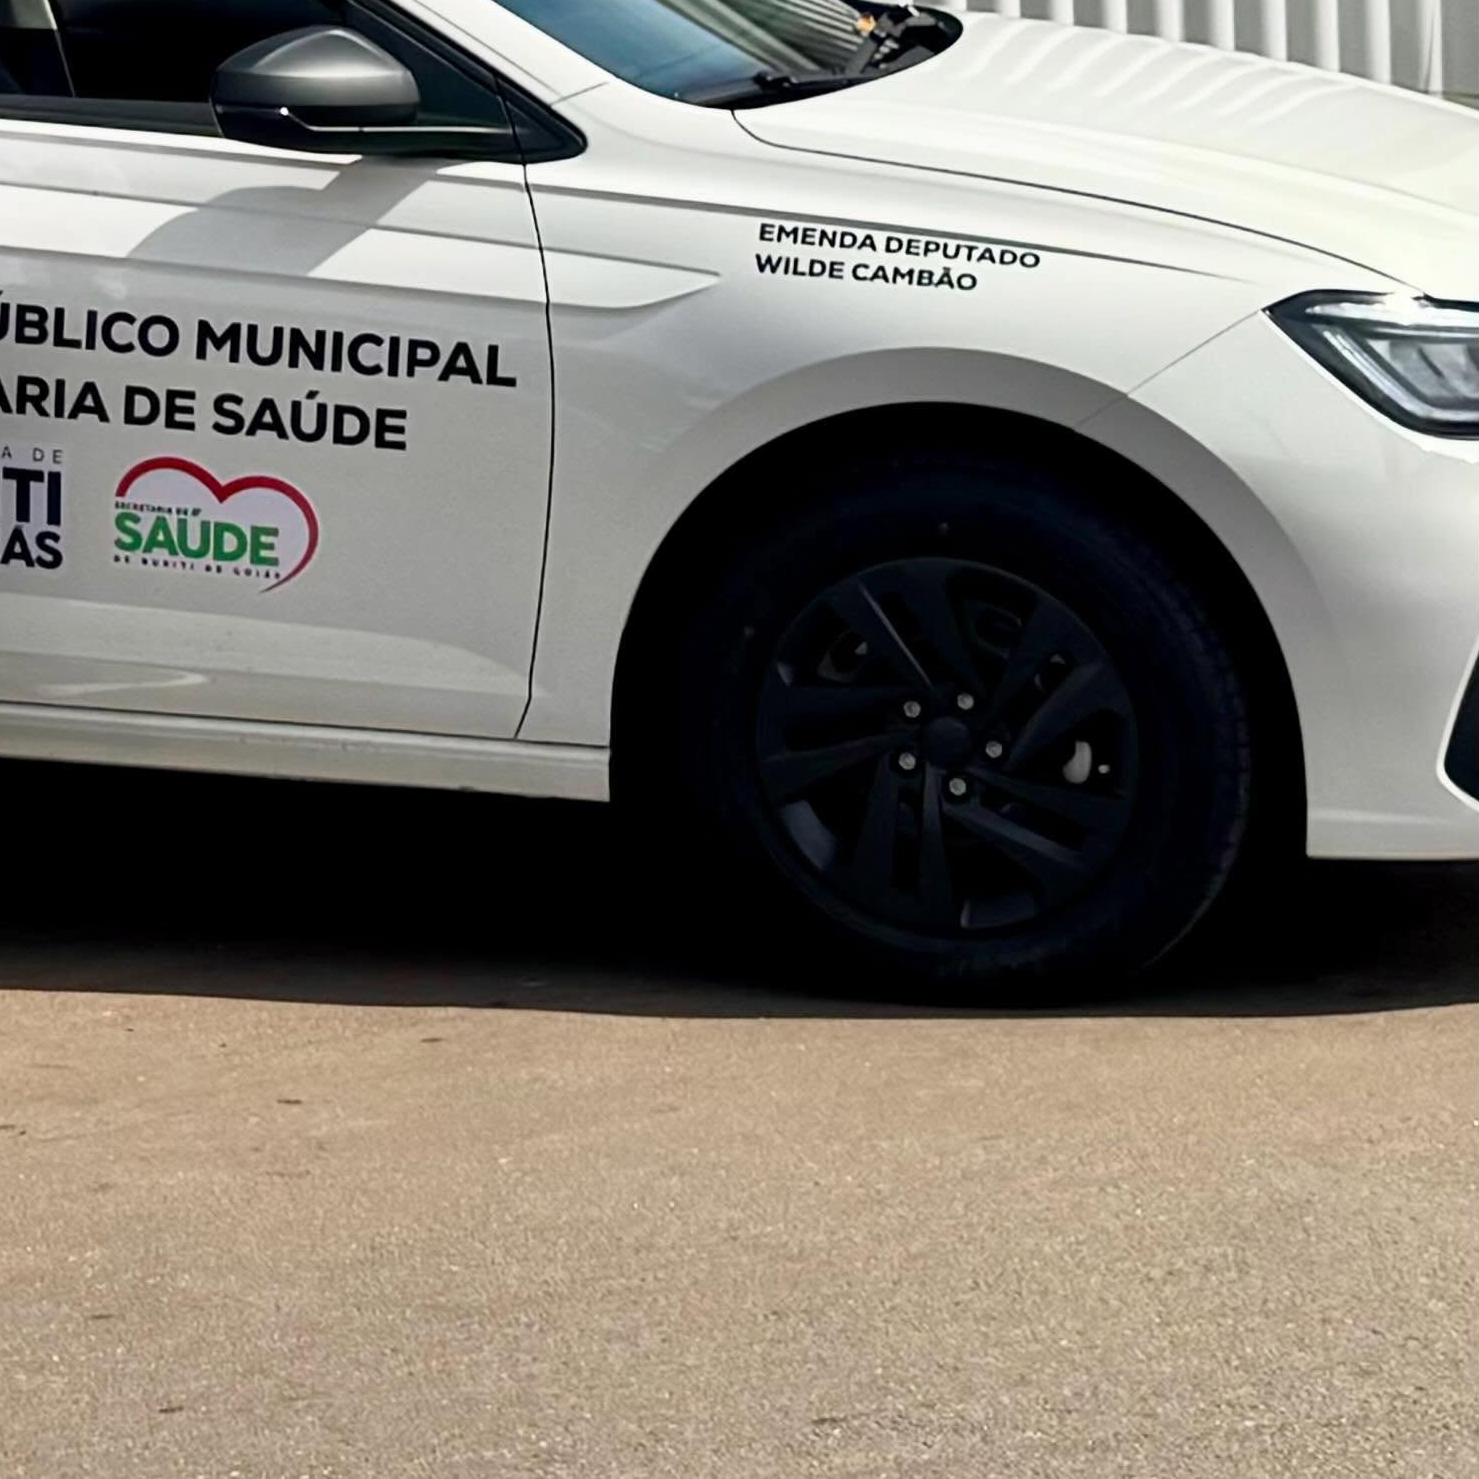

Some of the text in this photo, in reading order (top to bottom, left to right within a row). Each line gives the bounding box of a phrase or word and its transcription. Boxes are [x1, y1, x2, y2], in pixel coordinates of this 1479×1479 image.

[755, 253, 977, 291] WILDE CAMBÃO
[758, 223, 1040, 269] EMENDA DEPUTADO
[195, 319, 517, 388] MUNICIPAL
[123, 384, 196, 431] DE
[213, 391, 408, 451] SAÚDE
[32, 448, 63, 464] DE
[114, 507, 280, 567] SAÚDE
